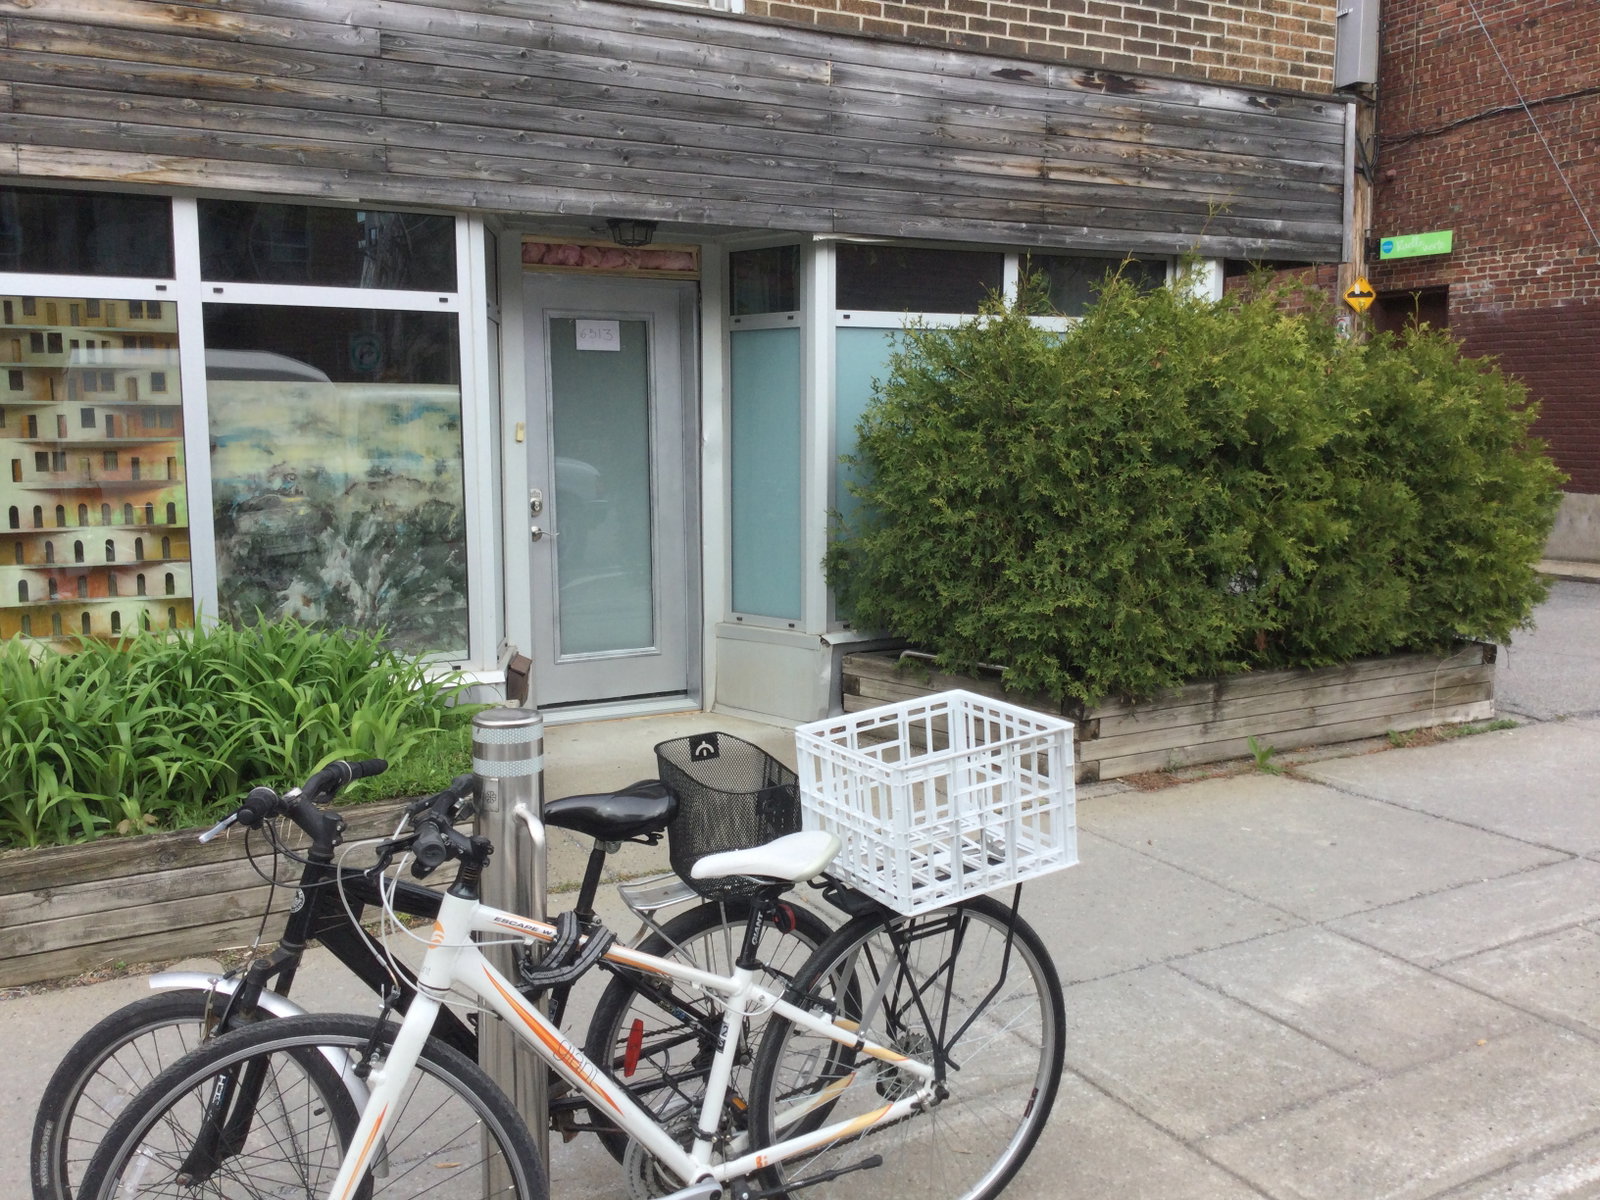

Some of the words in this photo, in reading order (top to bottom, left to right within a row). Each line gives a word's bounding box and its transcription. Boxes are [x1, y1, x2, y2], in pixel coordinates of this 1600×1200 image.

[494, 916, 539, 932] ESCAPE
[752, 911, 763, 946] GIANT
[40, 1119, 54, 1188] MONGOOSE
